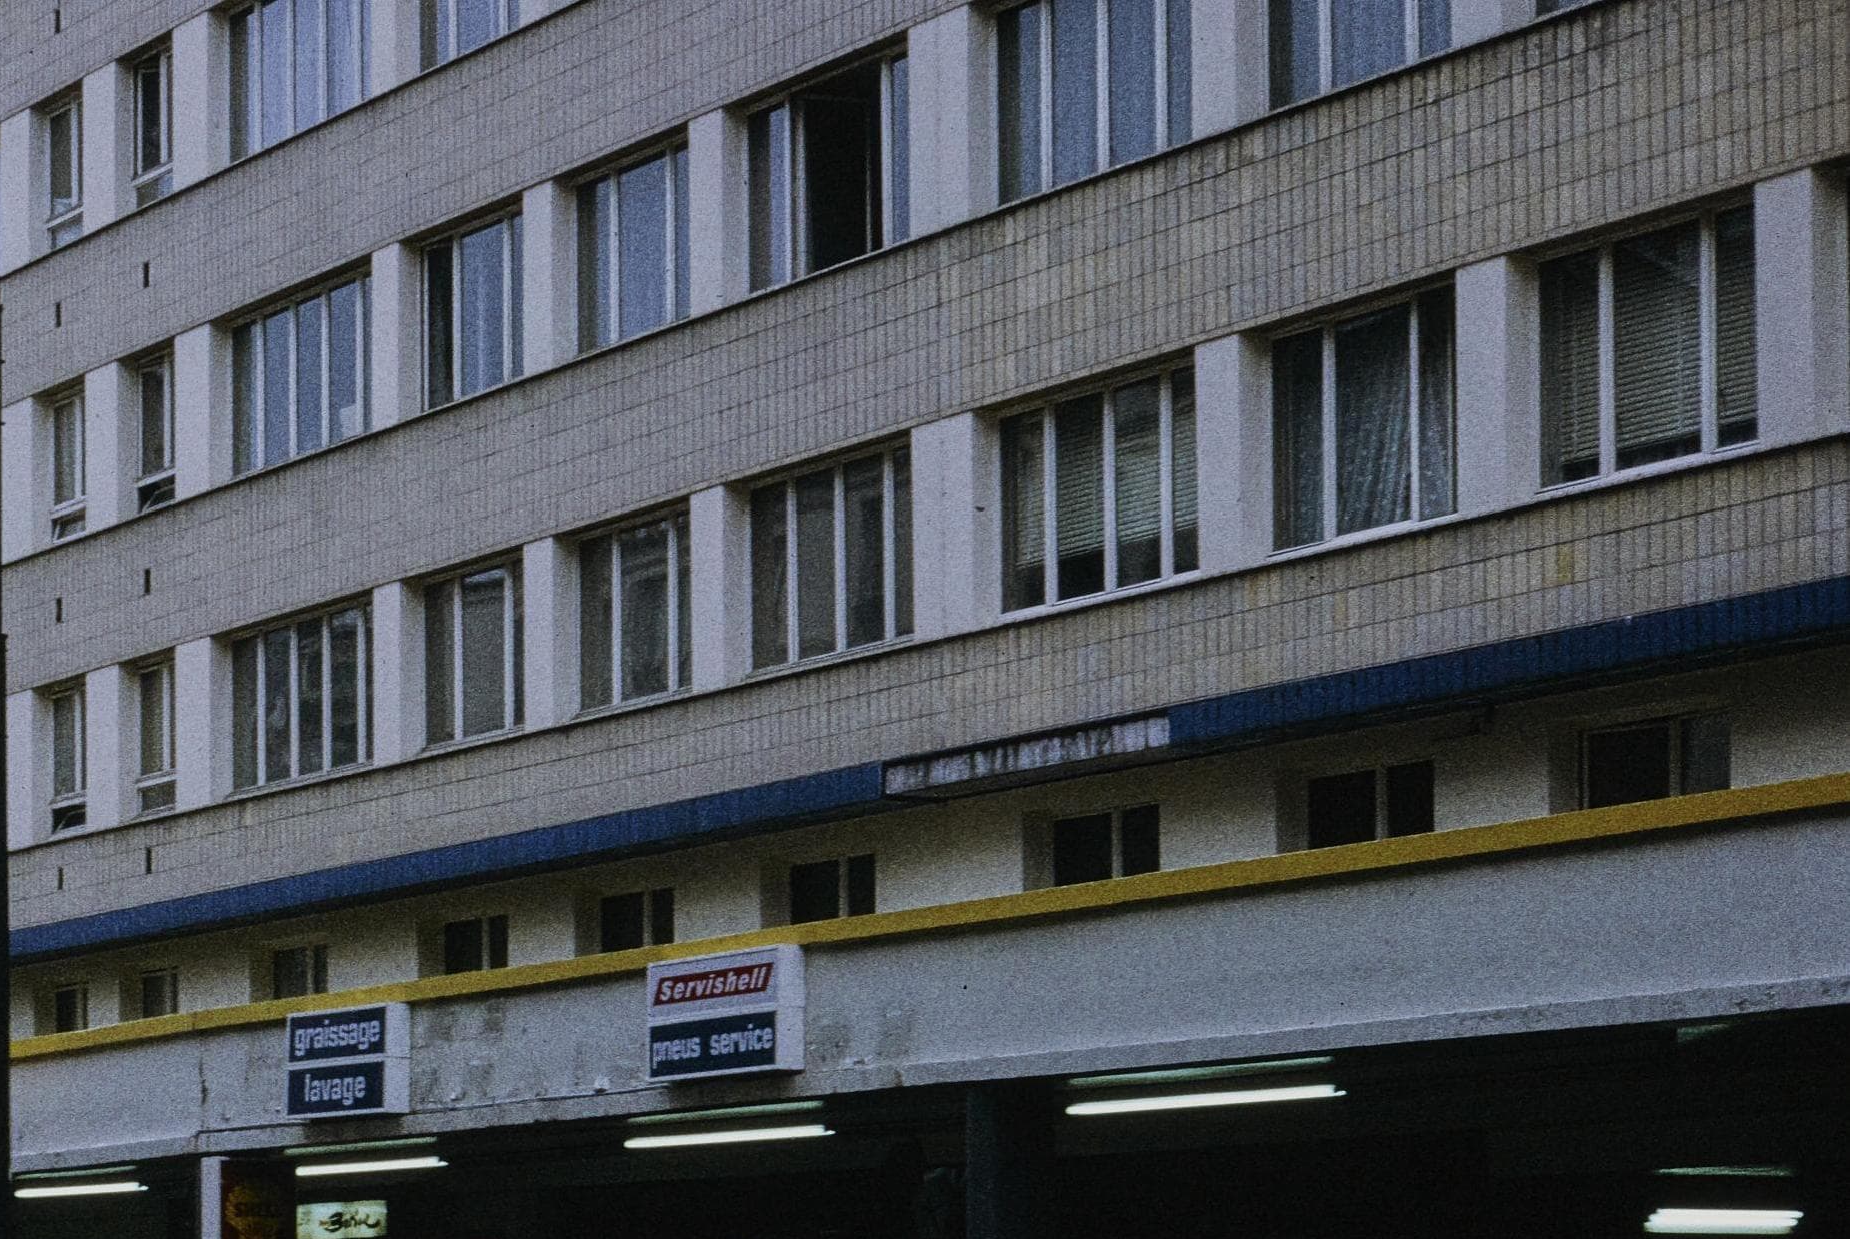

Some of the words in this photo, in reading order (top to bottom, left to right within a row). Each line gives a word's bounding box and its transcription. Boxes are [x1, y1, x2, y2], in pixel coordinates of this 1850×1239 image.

[658, 964, 769, 1004] Servishell
[294, 1018, 381, 1058] graissage
[653, 1033, 702, 1064] pneus
[709, 1021, 774, 1056] service
[303, 1073, 366, 1107] lavage
